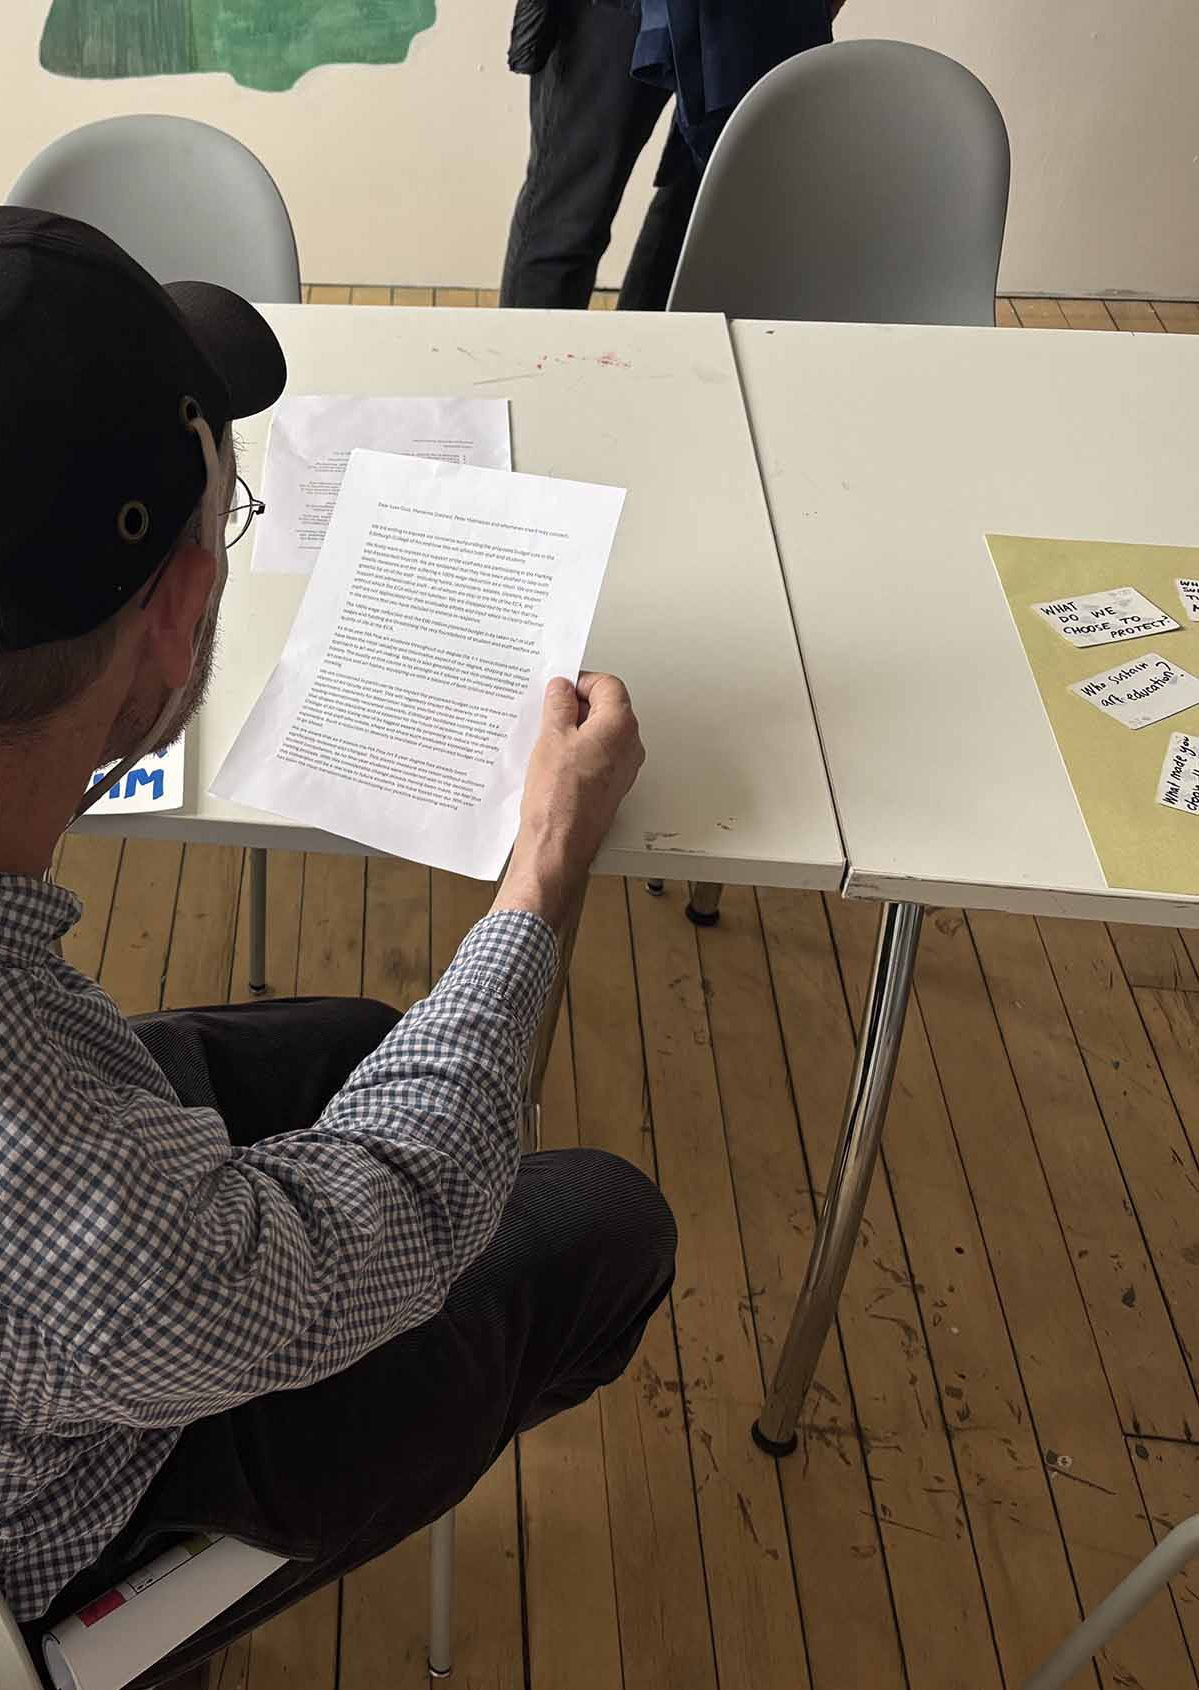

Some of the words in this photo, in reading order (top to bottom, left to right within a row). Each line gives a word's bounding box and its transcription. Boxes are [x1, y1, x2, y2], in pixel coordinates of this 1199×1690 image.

[1041, 602, 1078, 616] WHAT
[1058, 614, 1079, 624] DO
[1091, 606, 1116, 619] WE
[1063, 622, 1110, 635] CHOOSE
[1119, 615, 1141, 625] TO
[1081, 682, 1106, 698] Who
[1170, 755, 1188, 781] made
[1180, 736, 1196, 756] you
